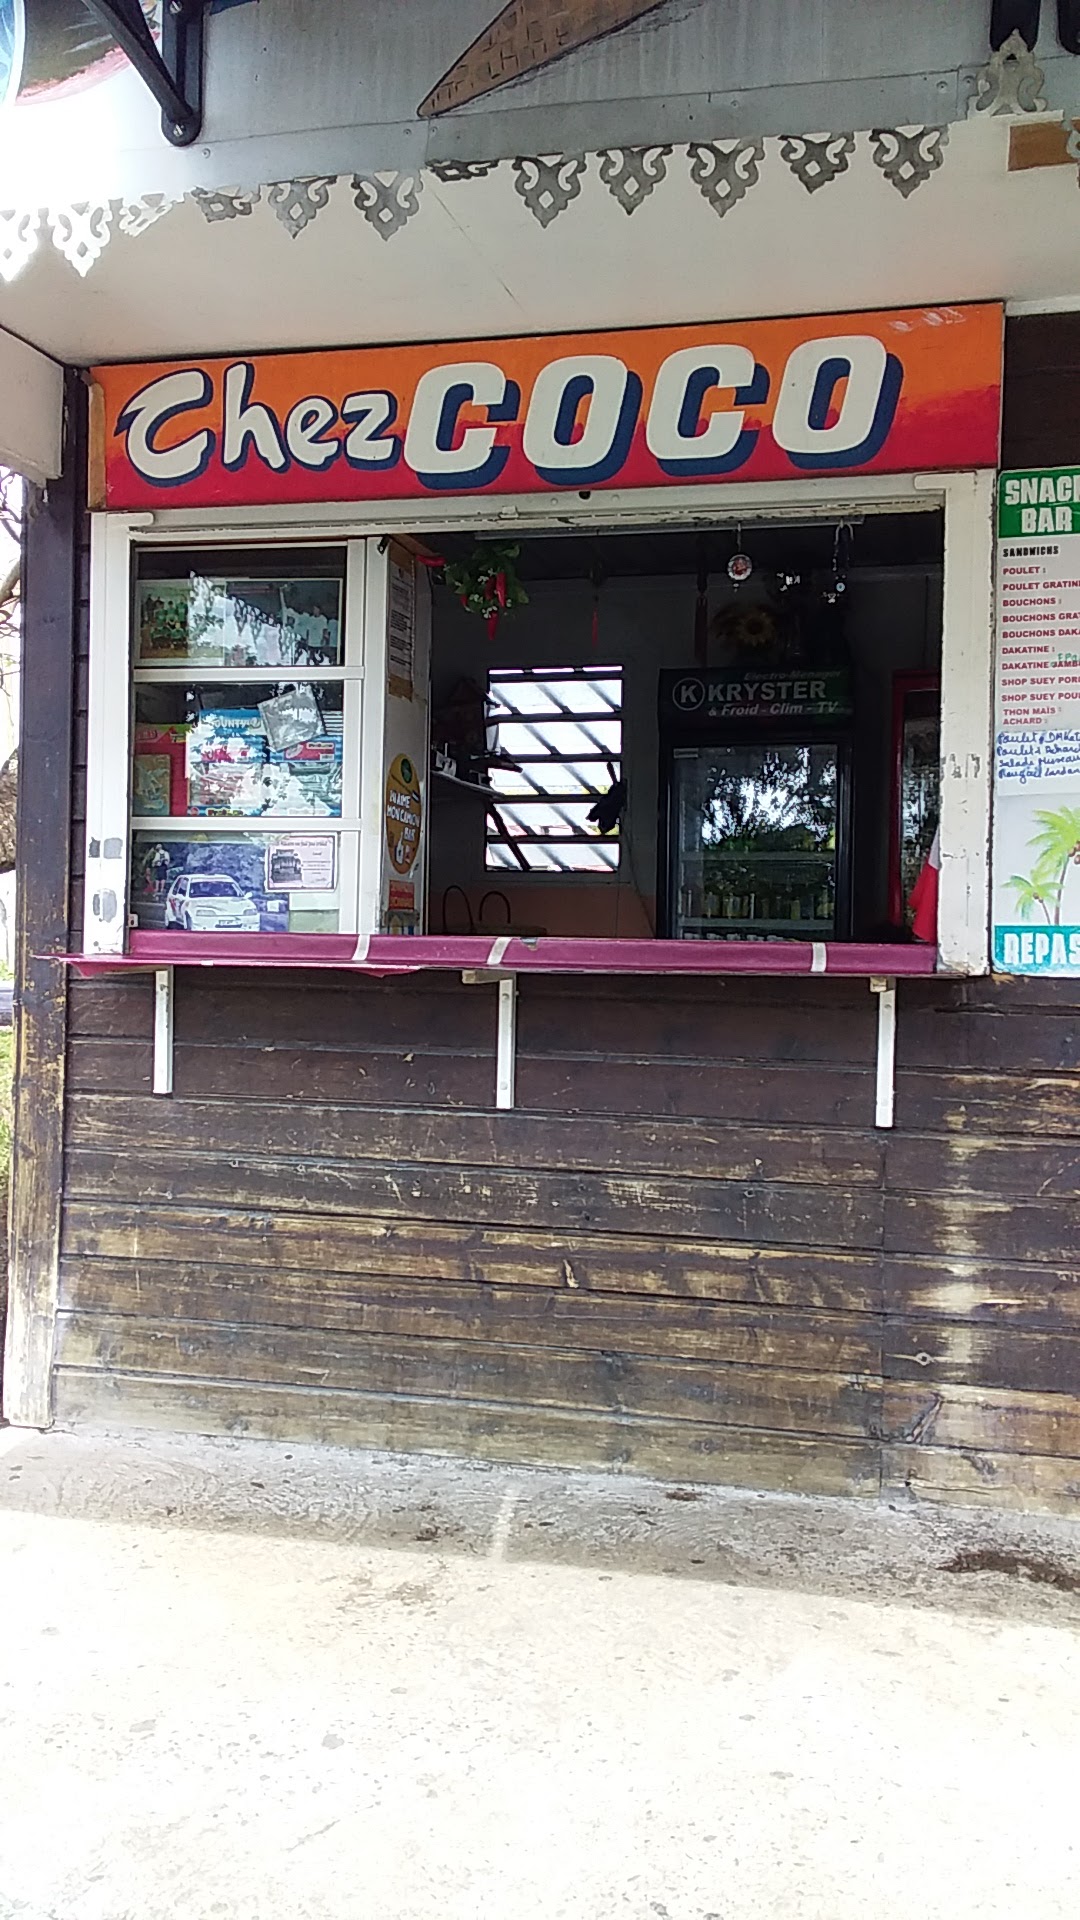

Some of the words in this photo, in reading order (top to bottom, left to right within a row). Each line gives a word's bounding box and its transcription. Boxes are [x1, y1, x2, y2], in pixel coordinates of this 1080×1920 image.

[114, 361, 400, 487] Chez
[403, 334, 904, 489] COCO
[1021, 506, 1073, 533] BAR
[1003, 545, 1059, 557] SANDWICHS
[1003, 566, 1040, 575] POULET
[1003, 582, 1040, 592] POULET
[1043, 580, 1080, 589] GRATIN
[1002, 597, 1056, 607] BOUCHONS
[1002, 613, 1056, 623] BOUCHONS
[1002, 629, 1056, 639] BOUCHONS
[1058, 628, 1080, 636] DAK
[1002, 645, 1049, 655] DAKATINE
[1002, 661, 1049, 670] DAKATINE
[1002, 678, 1027, 686] SHOP
[1030, 677, 1056, 685] SUEY
[1058, 676, 1080, 684] POR
[680, 685, 698, 703] K
[708, 680, 827, 702] KRYSTER
[1002, 694, 1027, 702] SHOP
[1030, 693, 1056, 701] SUEY
[1058, 692, 1080, 700] POU
[721, 703, 759, 716] Froid
[770, 702, 803, 715] Clim
[817, 701, 838, 713] TV
[1003, 708, 1029, 716] THON
[1002, 717, 1042, 725] ACHARD
[1004, 932, 1080, 965] REPAS
